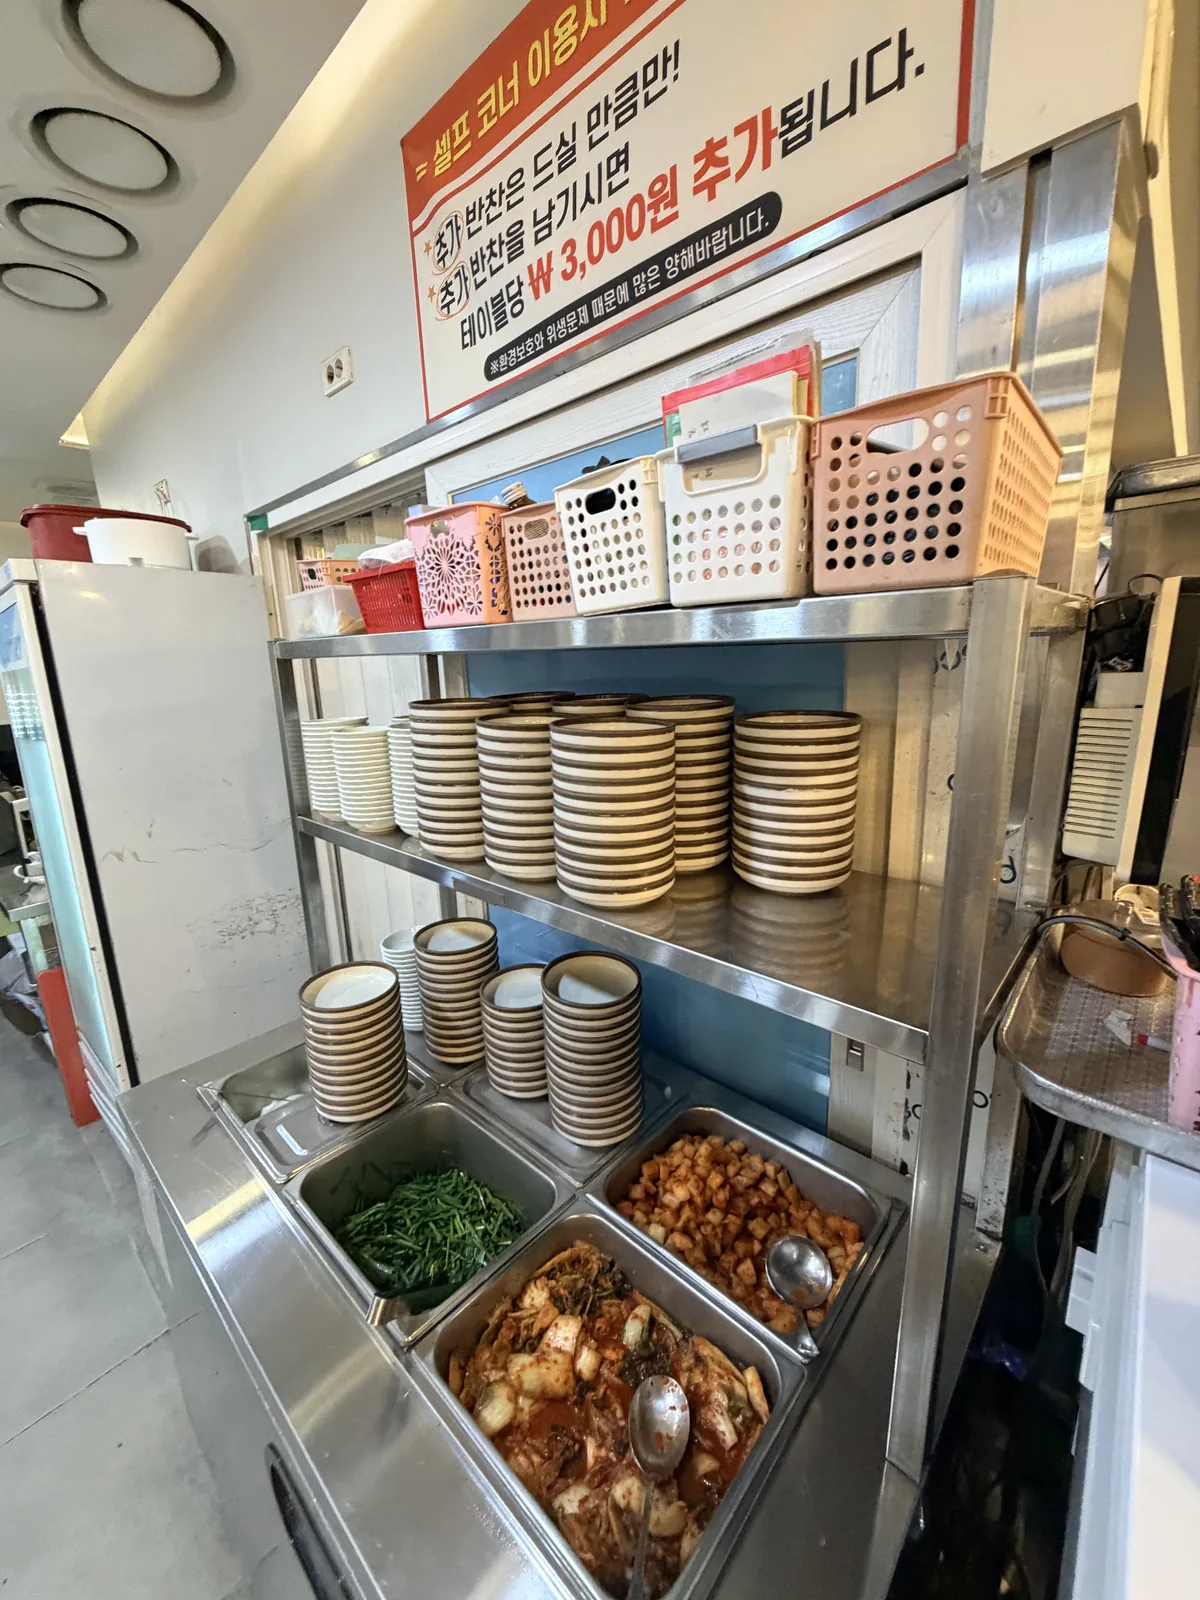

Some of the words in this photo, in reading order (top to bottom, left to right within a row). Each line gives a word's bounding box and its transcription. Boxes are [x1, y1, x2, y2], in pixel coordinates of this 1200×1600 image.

[434, 110, 471, 177] 셀프
[477, 60, 519, 138] 코너
[436, 214, 461, 268] 추가
[466, 167, 525, 240] 반찬은
[532, 121, 577, 192] 드실
[587, 38, 680, 152] 만큼만!
[460, 275, 525, 350] 테이블당
[560, 163, 679, 281] 3,000원
[693, 27, 925, 202] 추가됩니다.
[440, 264, 469, 315] 추가
[469, 219, 525, 291] 반찬을
[532, 140, 630, 247] 남기시면
[546, 305, 589, 343] 위생문제
[592, 281, 630, 318] 때문에
[632, 265, 661, 297] 많은
[665, 207, 770, 280] 양해바랍니다.
